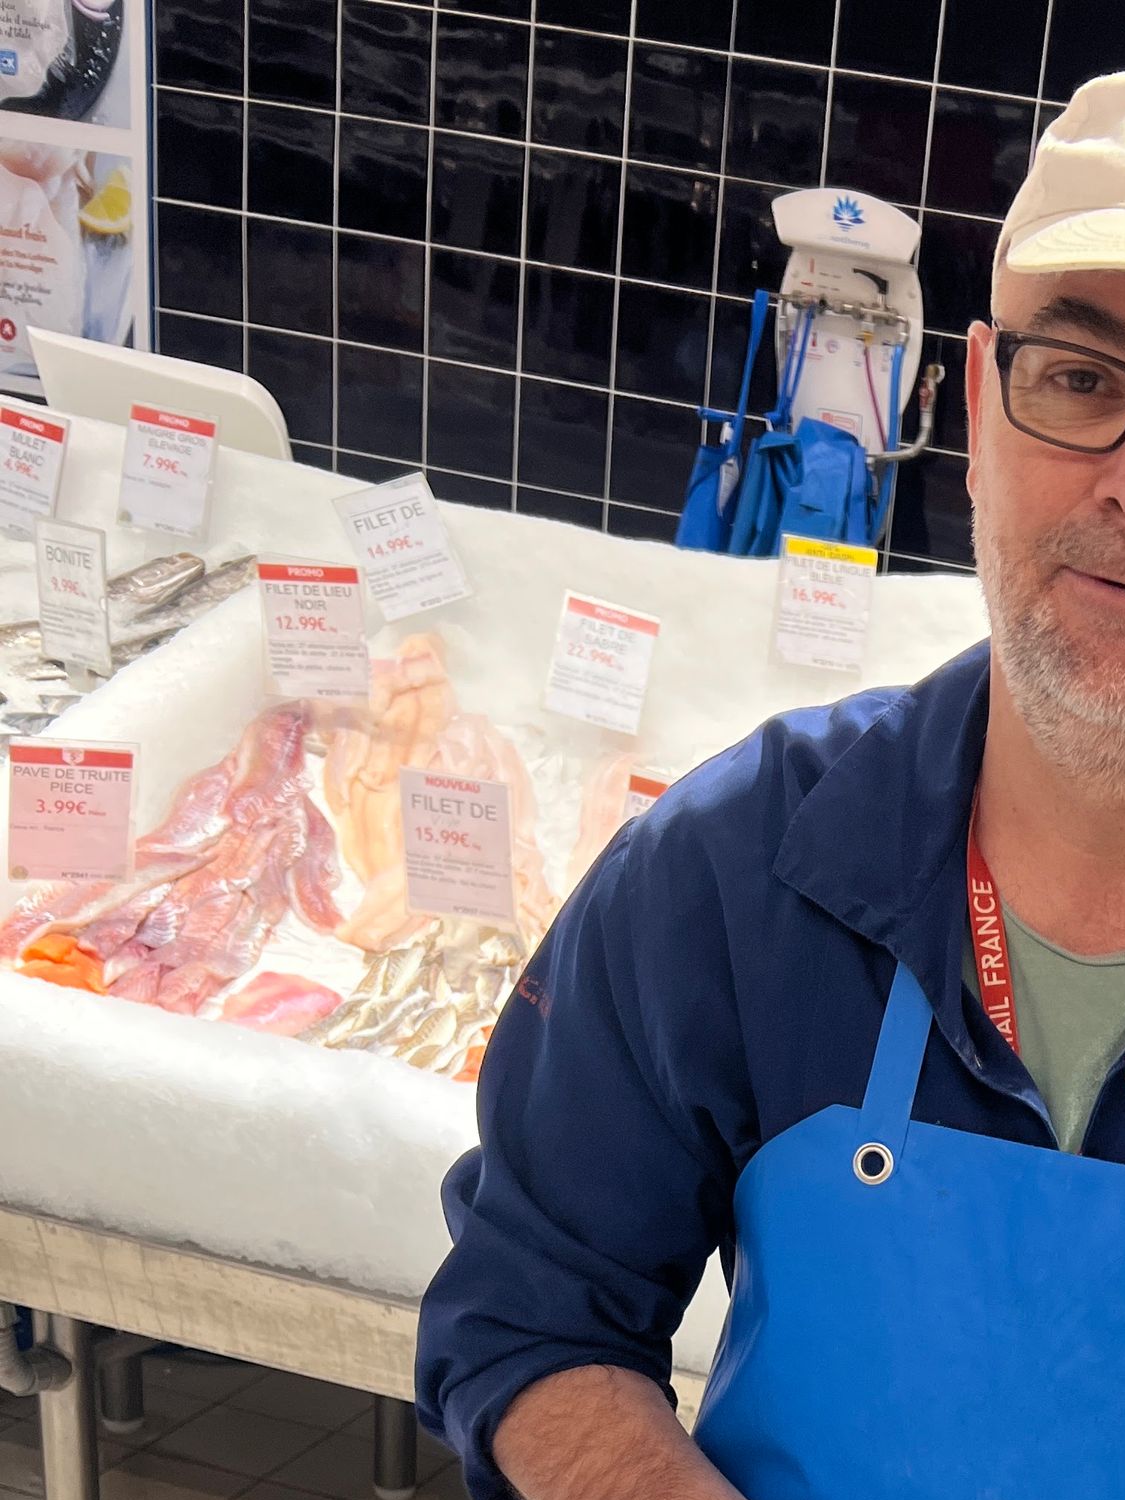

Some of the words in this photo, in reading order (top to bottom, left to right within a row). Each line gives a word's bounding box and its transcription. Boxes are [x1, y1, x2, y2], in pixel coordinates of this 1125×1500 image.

[353, 509, 398, 534] FILET
[400, 501, 425, 520] DE
[45, 545, 92, 570] BONITE
[265, 584, 299, 595] FILET
[302, 585, 321, 596] DE
[323, 586, 352, 598] LIEU
[294, 600, 328, 611] NOIR
[13, 765, 50, 778] PAVE
[54, 768, 75, 780] DE
[79, 769, 131, 783] TRUITE
[50, 782, 94, 795] PIECE
[424, 776, 481, 793] NOUVEAU
[35, 799, 87, 815] 3.99€
[411, 794, 464, 816] FILET
[470, 802, 497, 822] DE
[972, 878, 1007, 987] FRANCE
